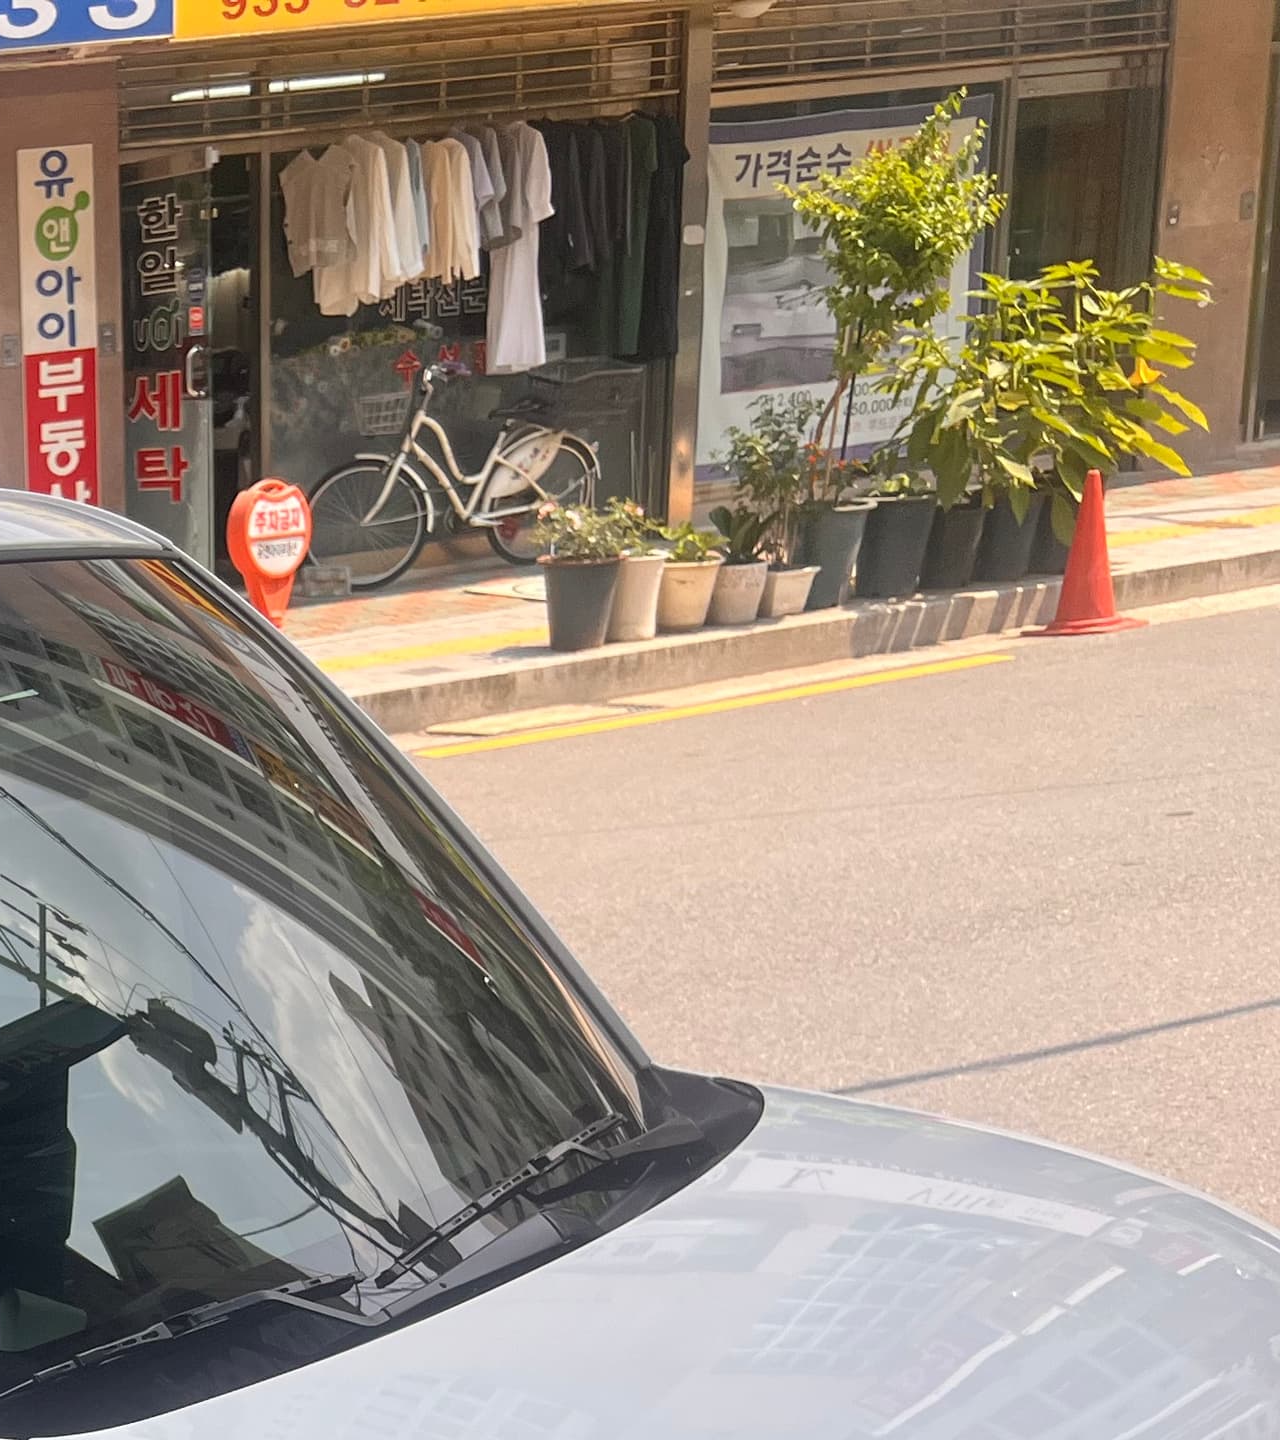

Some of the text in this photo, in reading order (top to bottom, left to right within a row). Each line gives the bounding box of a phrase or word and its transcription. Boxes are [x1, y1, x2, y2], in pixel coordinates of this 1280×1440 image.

[734, 143, 852, 189] 가격순수
[34, 150, 83, 347] 유앤아이
[137, 193, 183, 296] 한일
[128, 371, 190, 504] 세탁
